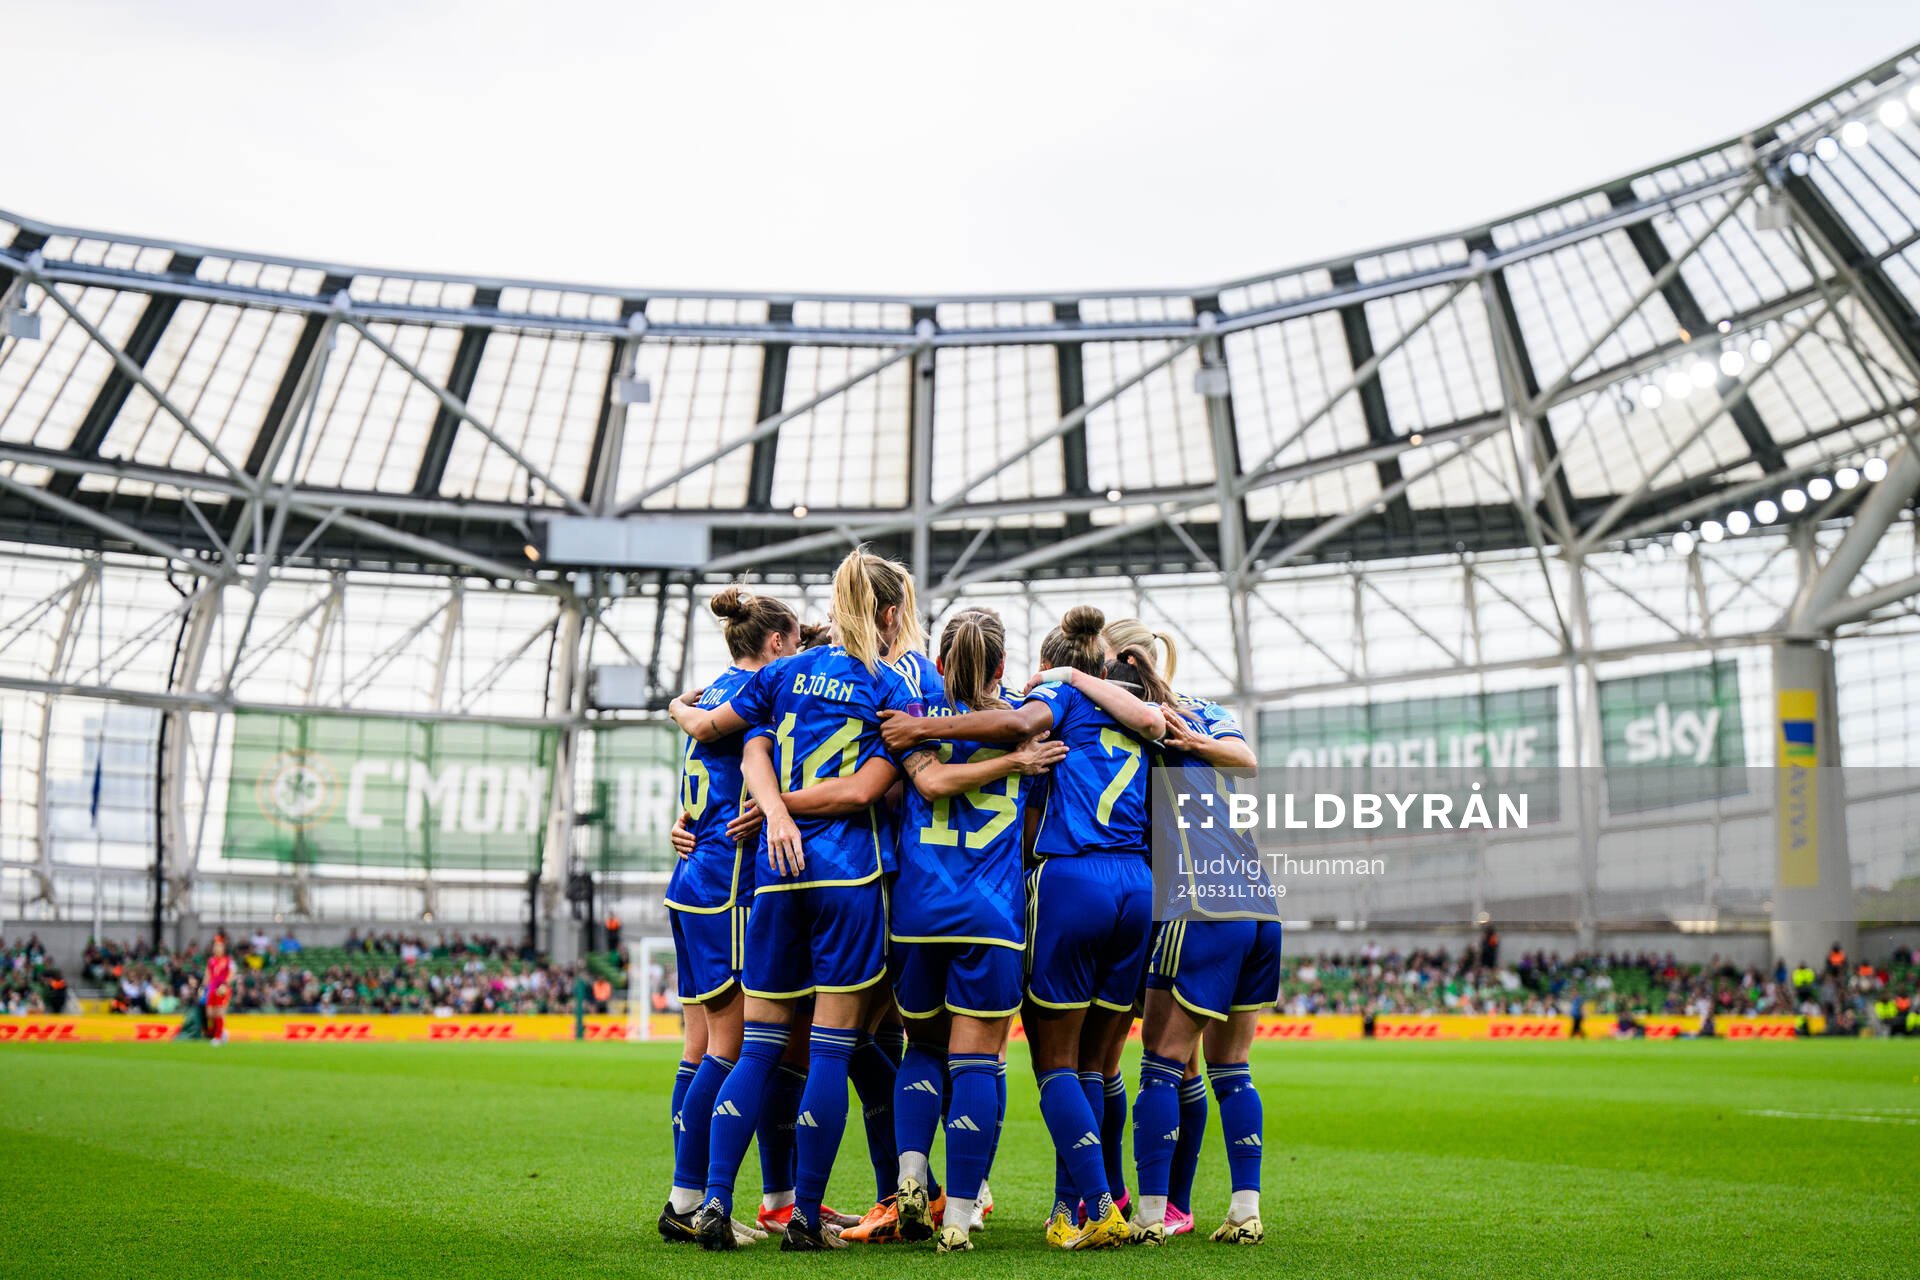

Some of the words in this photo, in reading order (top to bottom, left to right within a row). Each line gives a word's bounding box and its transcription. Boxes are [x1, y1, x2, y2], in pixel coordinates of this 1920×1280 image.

[792, 673, 854, 702] BJÖRN
[776, 712, 863, 793] 14
[1284, 726, 1538, 803] OUTBELIEVE
[1625, 702, 1720, 764] sky
[347, 759, 548, 833] C'MON
[920, 743, 1021, 849] 19
[1095, 726, 1141, 827] 7
[285, 1024, 373, 1039] DHL
[430, 1024, 514, 1039] DHL
[1489, 1024, 1562, 1038] DHL
